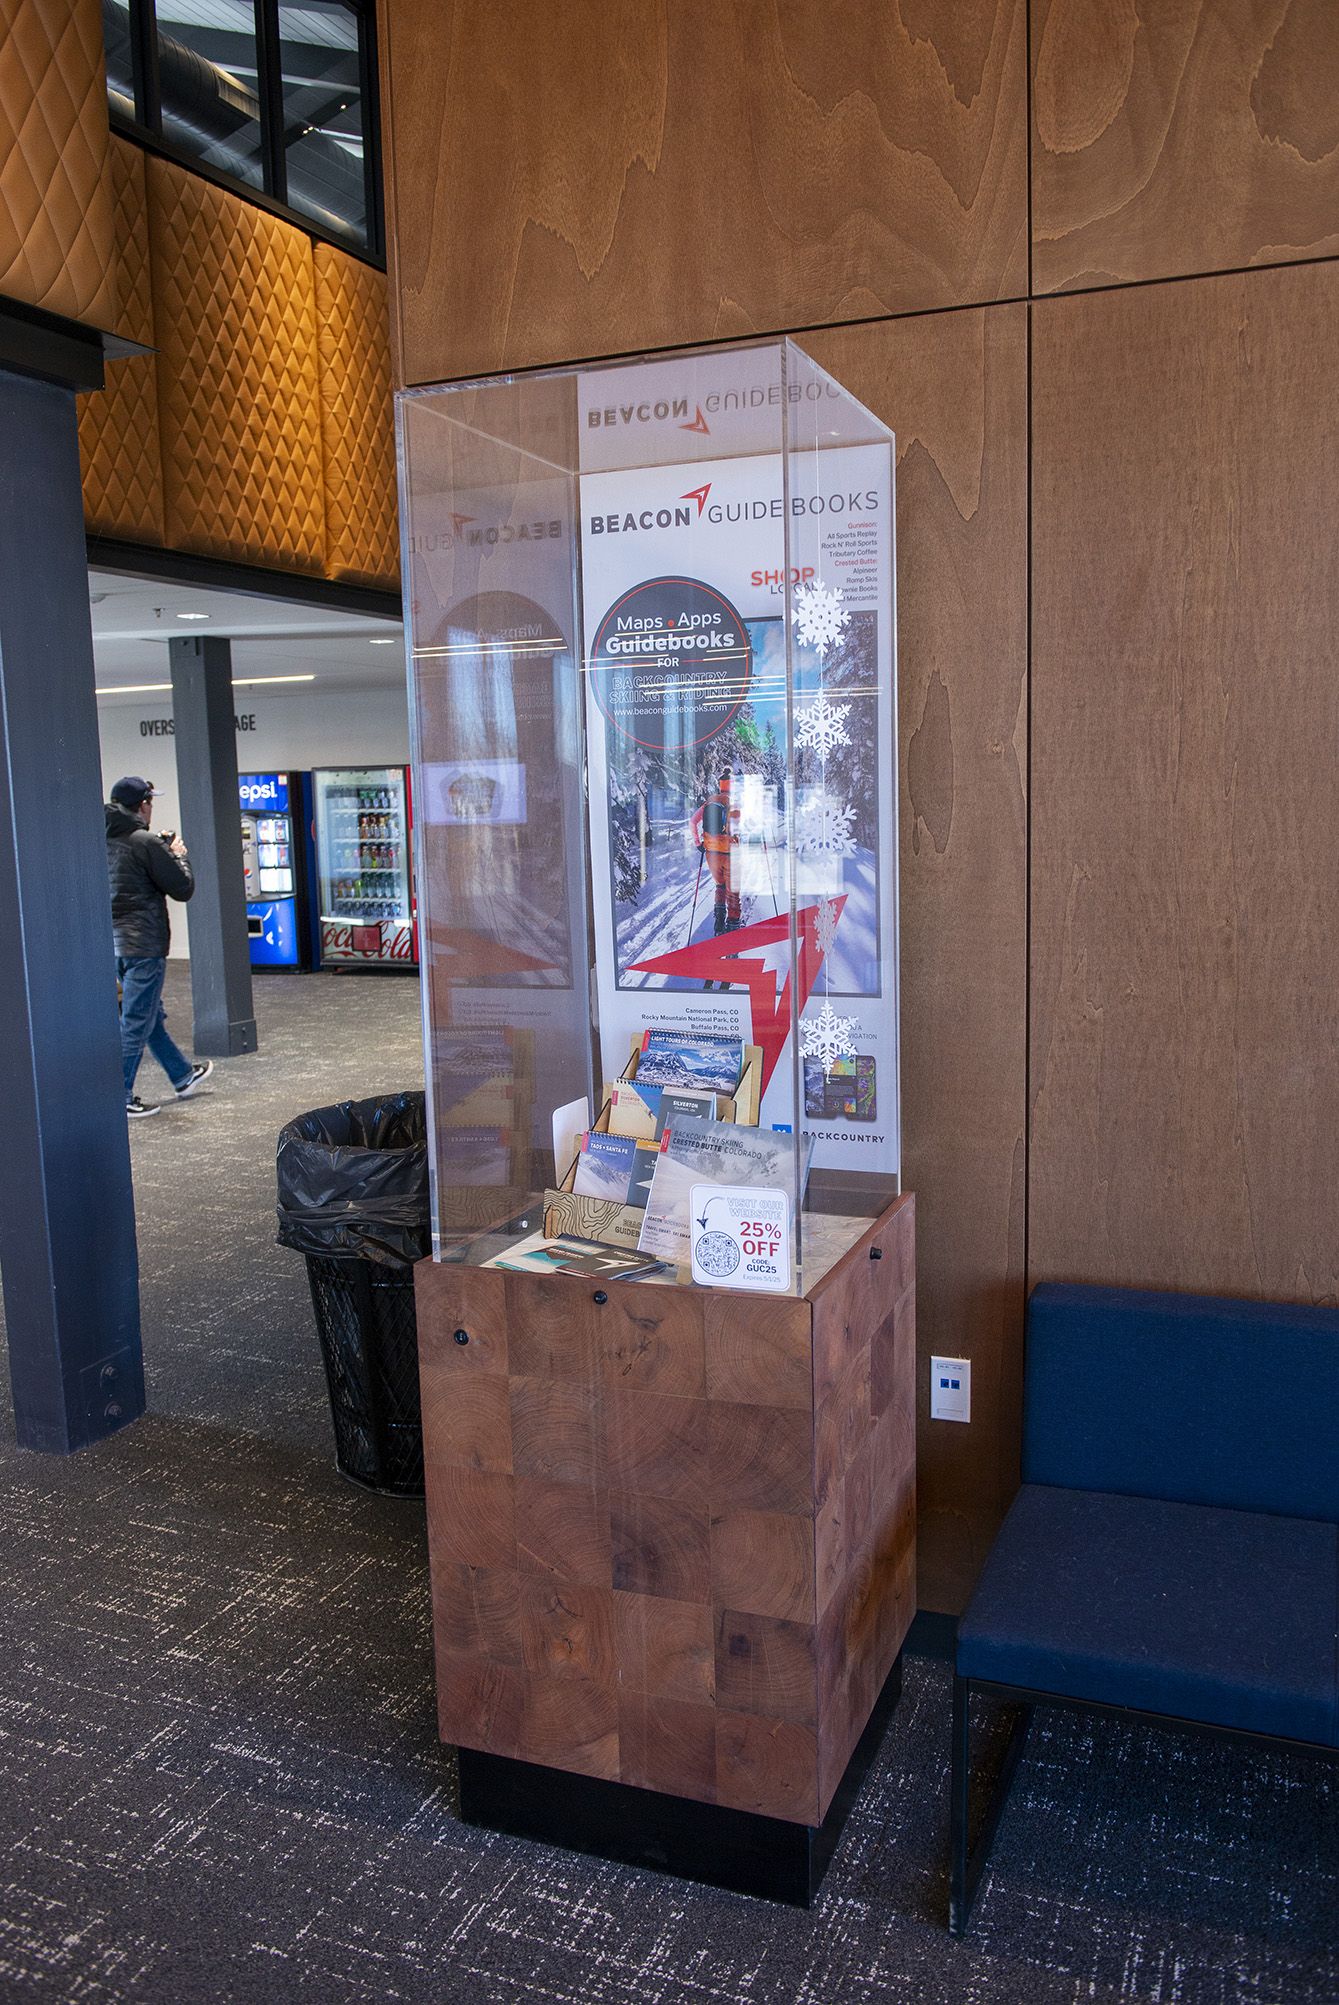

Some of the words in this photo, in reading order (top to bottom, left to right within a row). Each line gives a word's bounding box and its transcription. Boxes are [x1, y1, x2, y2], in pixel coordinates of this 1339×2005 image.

[591, 507, 691, 535] BEACON
[836, 532, 856, 540] Sports
[830, 550, 856, 558] Tributary
[834, 559, 858, 567] Crested
[751, 567, 815, 586] SHOP
[617, 616, 663, 632] Maps
[677, 612, 722, 628] Apps
[606, 630, 735, 654] Guidebooks
[657, 657, 680, 668] FOR
[612, 671, 728, 690] BACKCOUNTRY
[609, 689, 661, 704] SKIING
[140, 720, 175, 736] OVERS
[239, 781, 278, 803] epsi
[673, 1100, 699, 1109] SILVERTON
[672, 1137, 700, 1148] CRESTED
[700, 1143, 722, 1152] BUTTE
[724, 1146, 762, 1160] COLORADO
[673, 1130, 721, 1144] BACKCOUNTRY
[721, 1138, 744, 1149] SKIING
[740, 1221, 782, 1239] 25%
[742, 1239, 780, 1257] OFF
[746, 1263, 777, 1274] GUC25
